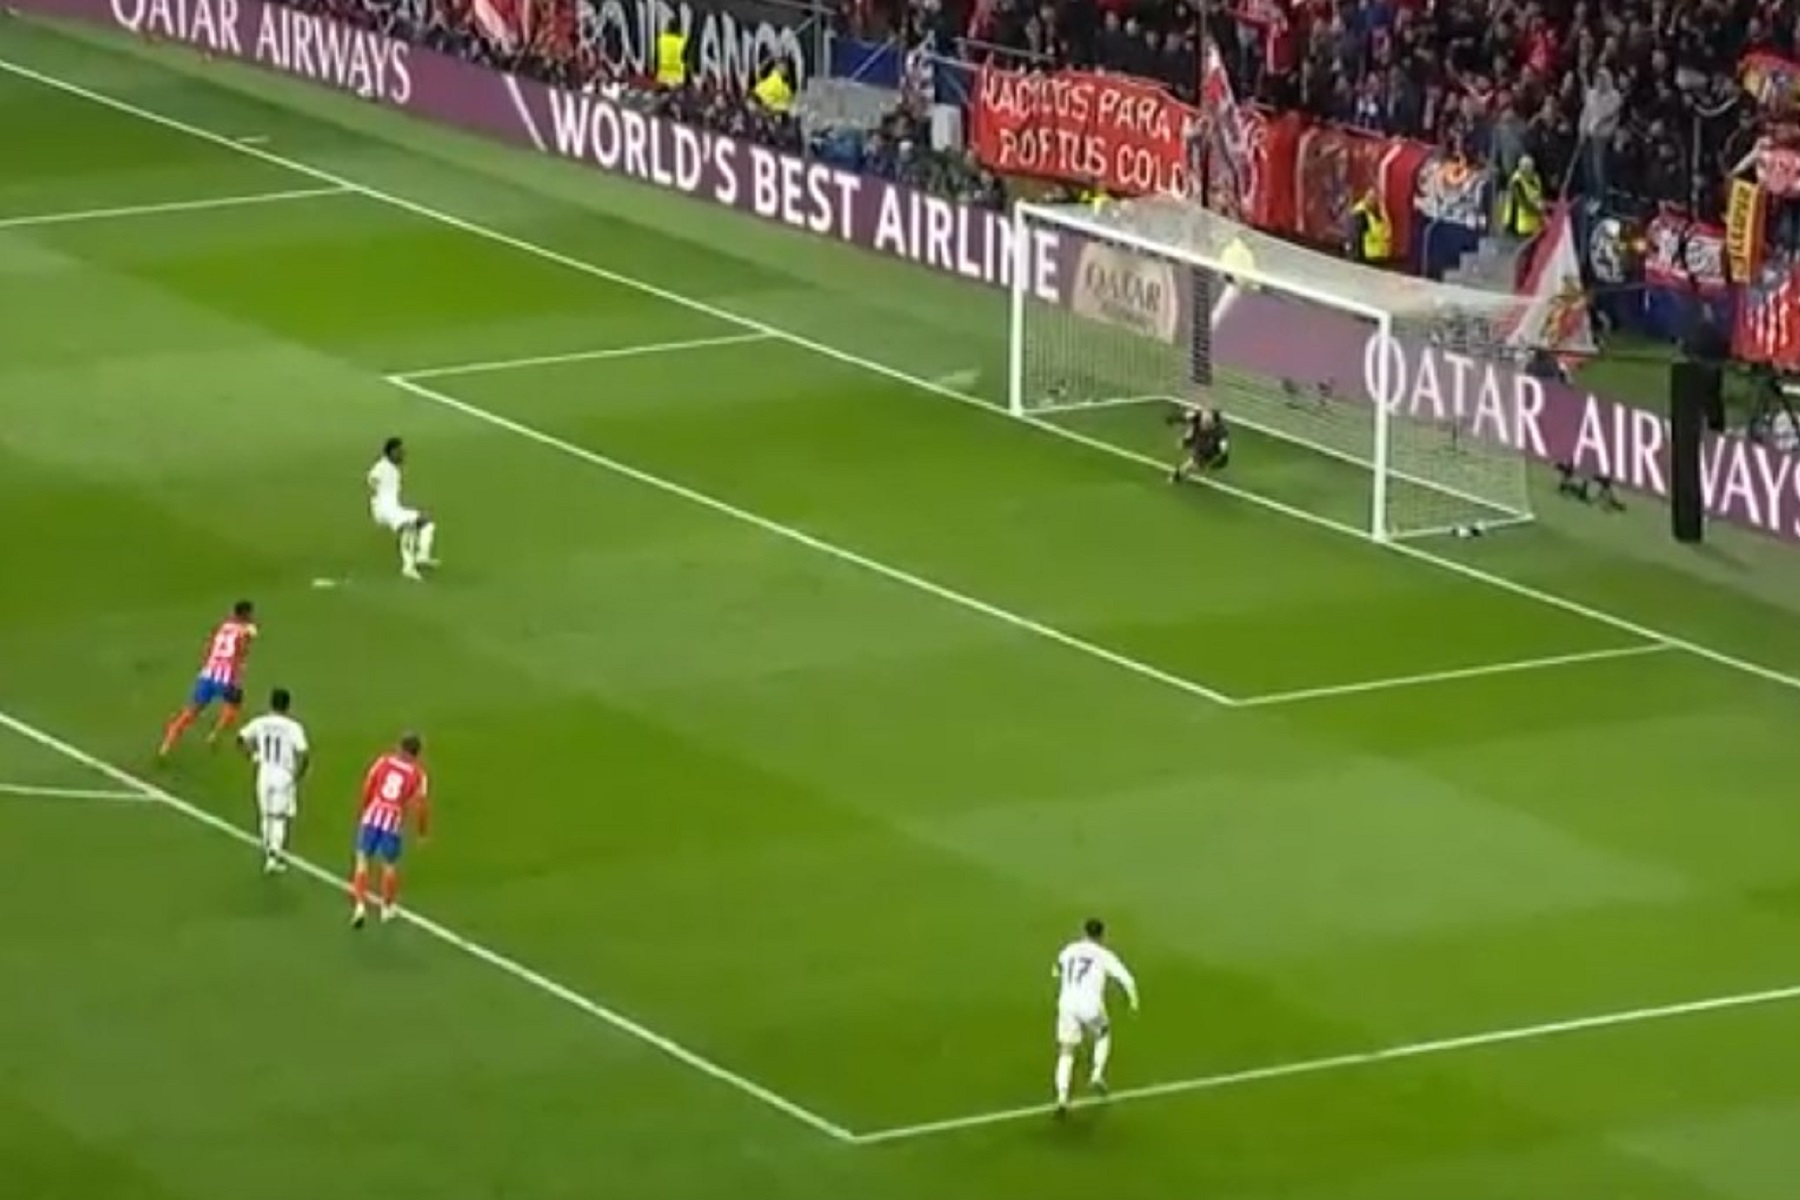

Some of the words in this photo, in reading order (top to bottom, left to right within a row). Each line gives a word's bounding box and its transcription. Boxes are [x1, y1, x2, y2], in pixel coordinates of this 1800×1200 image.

[111, 0, 241, 54] QATAR
[256, 2, 411, 103] AIRWAYS
[549, 88, 738, 205] WORLD'S
[749, 148, 861, 240] BEST
[874, 184, 1060, 303] AIRLINE
[1364, 331, 1547, 457] QATAR
[264, 735, 281, 763] 11
[381, 769, 404, 800] 8
[1067, 956, 1094, 985] 17
